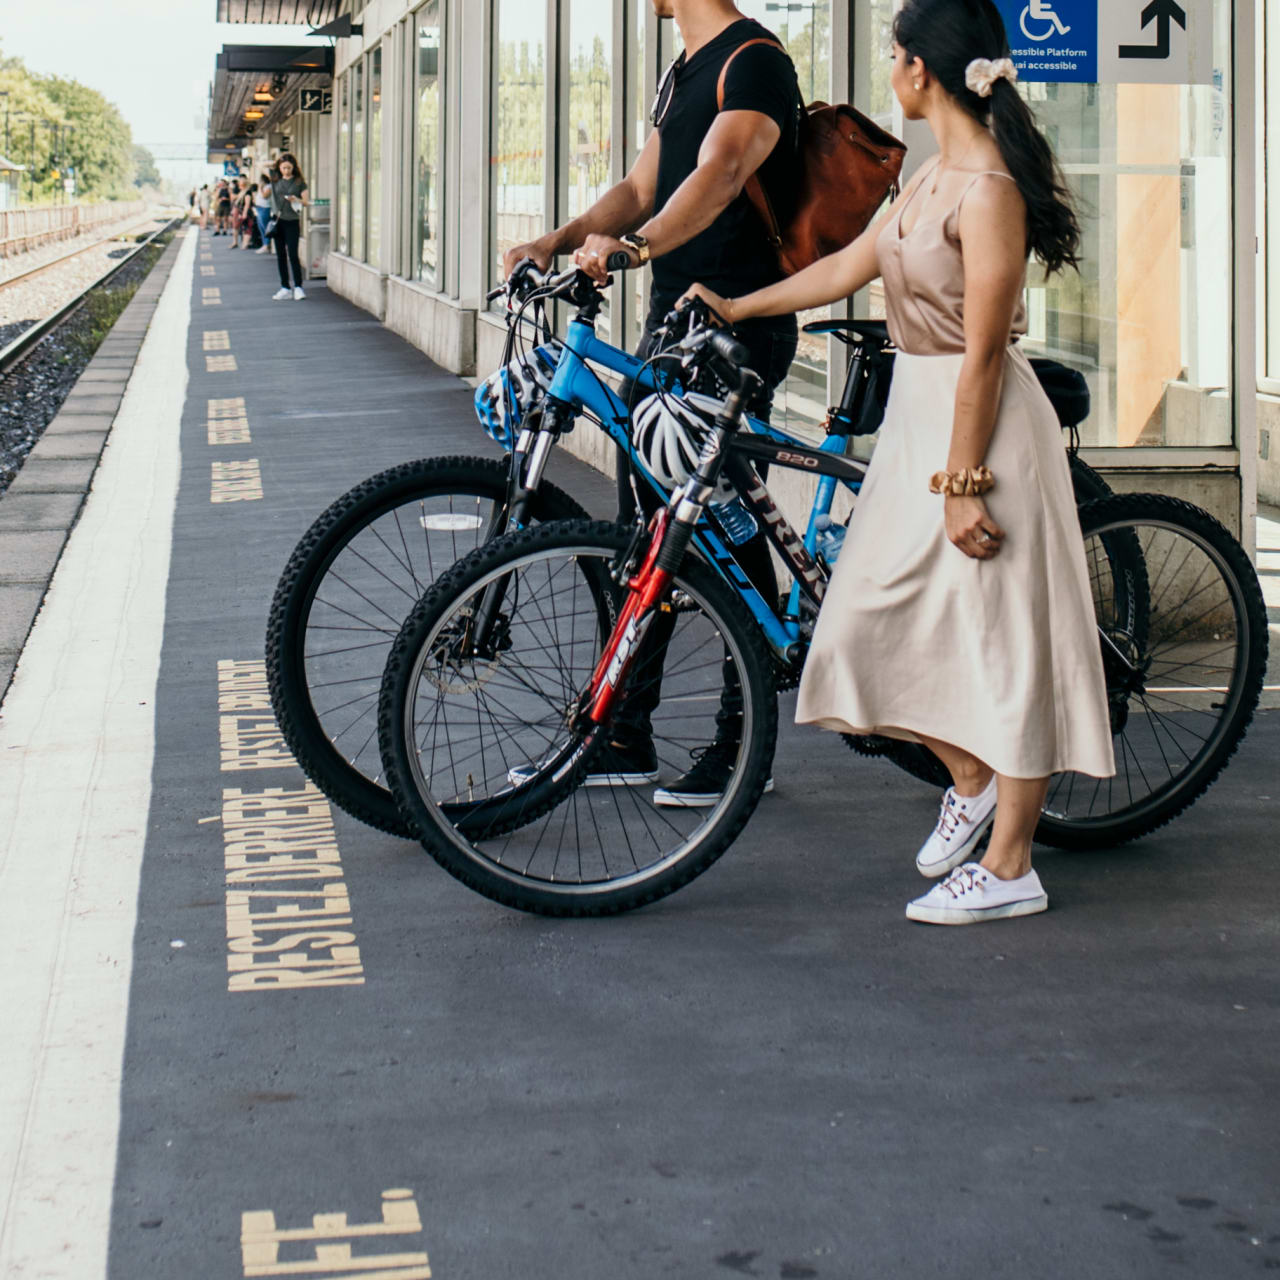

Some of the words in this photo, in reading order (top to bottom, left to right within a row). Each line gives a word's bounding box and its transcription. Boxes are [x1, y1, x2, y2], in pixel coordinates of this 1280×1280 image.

[1027, 61, 1078, 71] accessible
[1046, 47, 1088, 57] Platform
[775, 451, 820, 468] 820
[747, 475, 828, 602] TREK
[219, 715, 299, 771] RESTEZ
[197, 780, 344, 884] DERRIÈRE
[226, 882, 366, 992] RESTEZ
